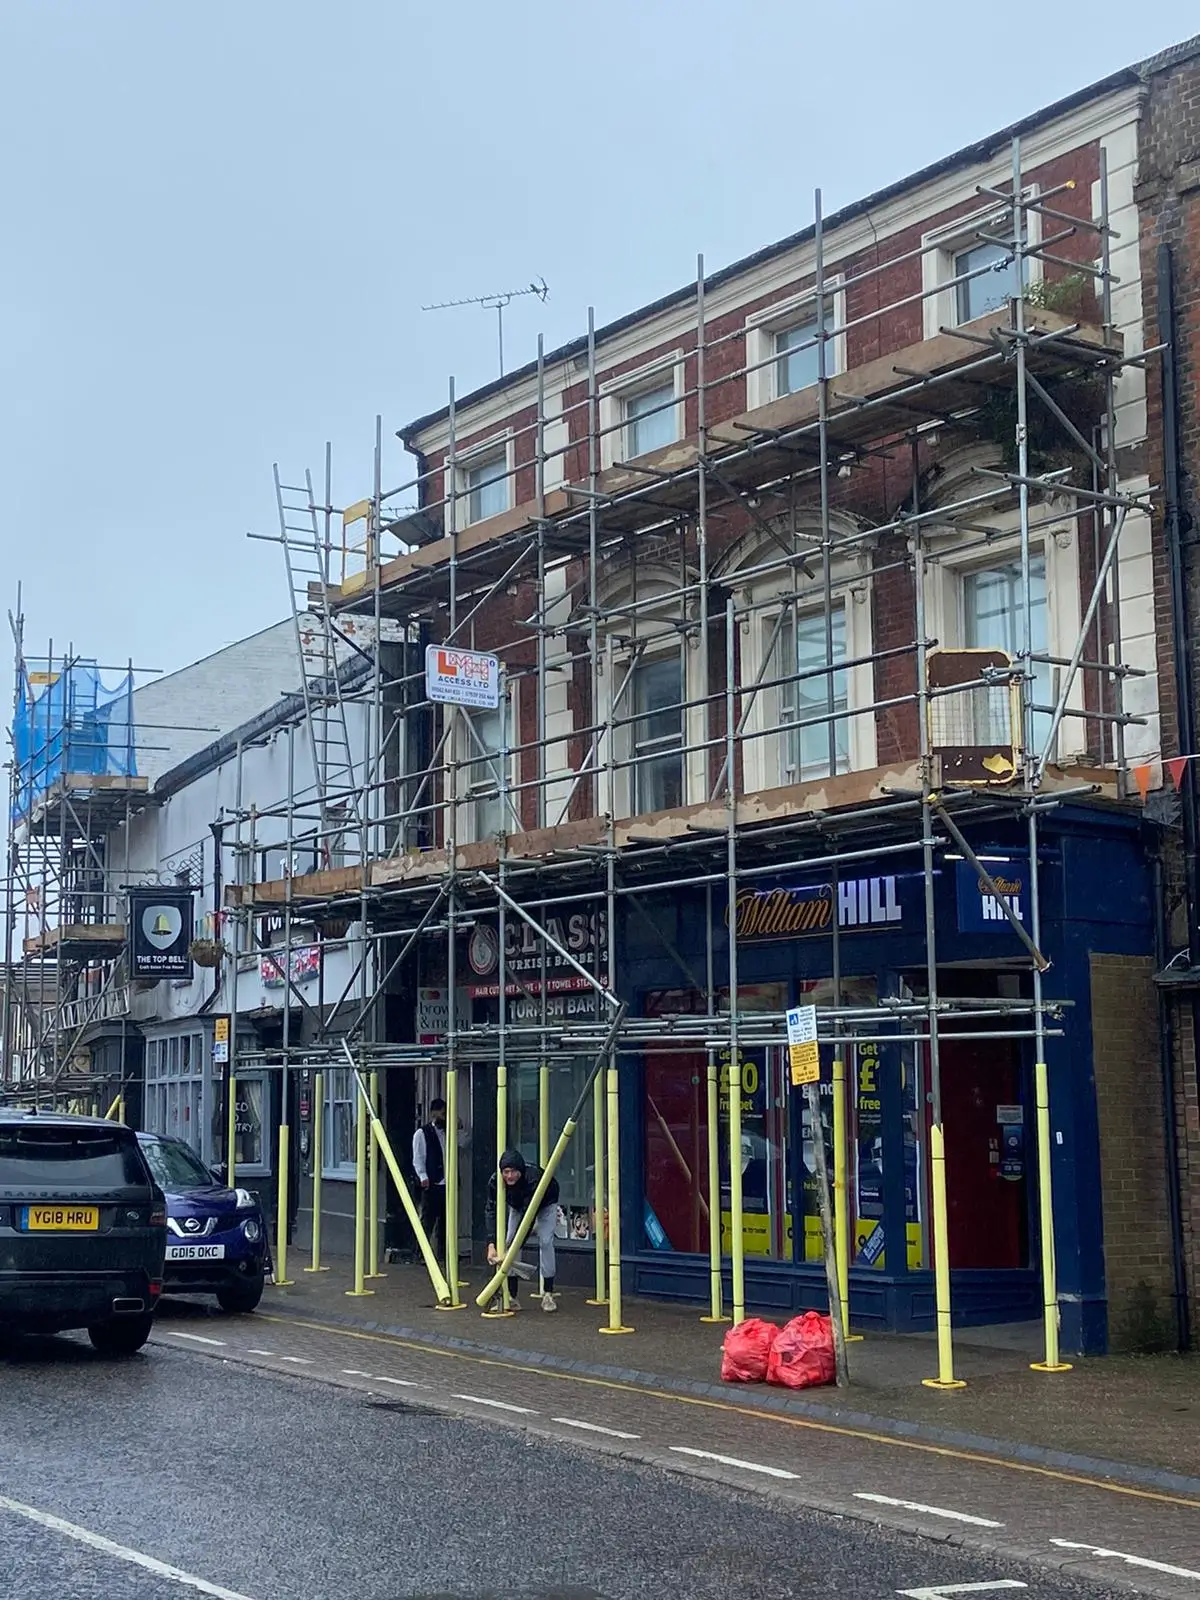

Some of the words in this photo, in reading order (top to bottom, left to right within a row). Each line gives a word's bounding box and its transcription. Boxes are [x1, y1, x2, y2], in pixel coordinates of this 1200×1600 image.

[438, 676, 471, 687] ACCESS
[473, 680, 489, 689] LTD
[726, 883, 833, 937] William
[838, 876, 902, 926] HILL
[475, 986, 488, 995] HAIR
[552, 980, 571, 990] TOWEL
[420, 1015, 430, 1029] &
[859, 1043, 878, 1055] Get
[859, 1096, 881, 1110] free
[34, 1211, 64, 1224] YG18
[67, 1211, 92, 1224] HRU
[172, 1247, 195, 1258] GD15
[198, 1246, 218, 1257] OKC
